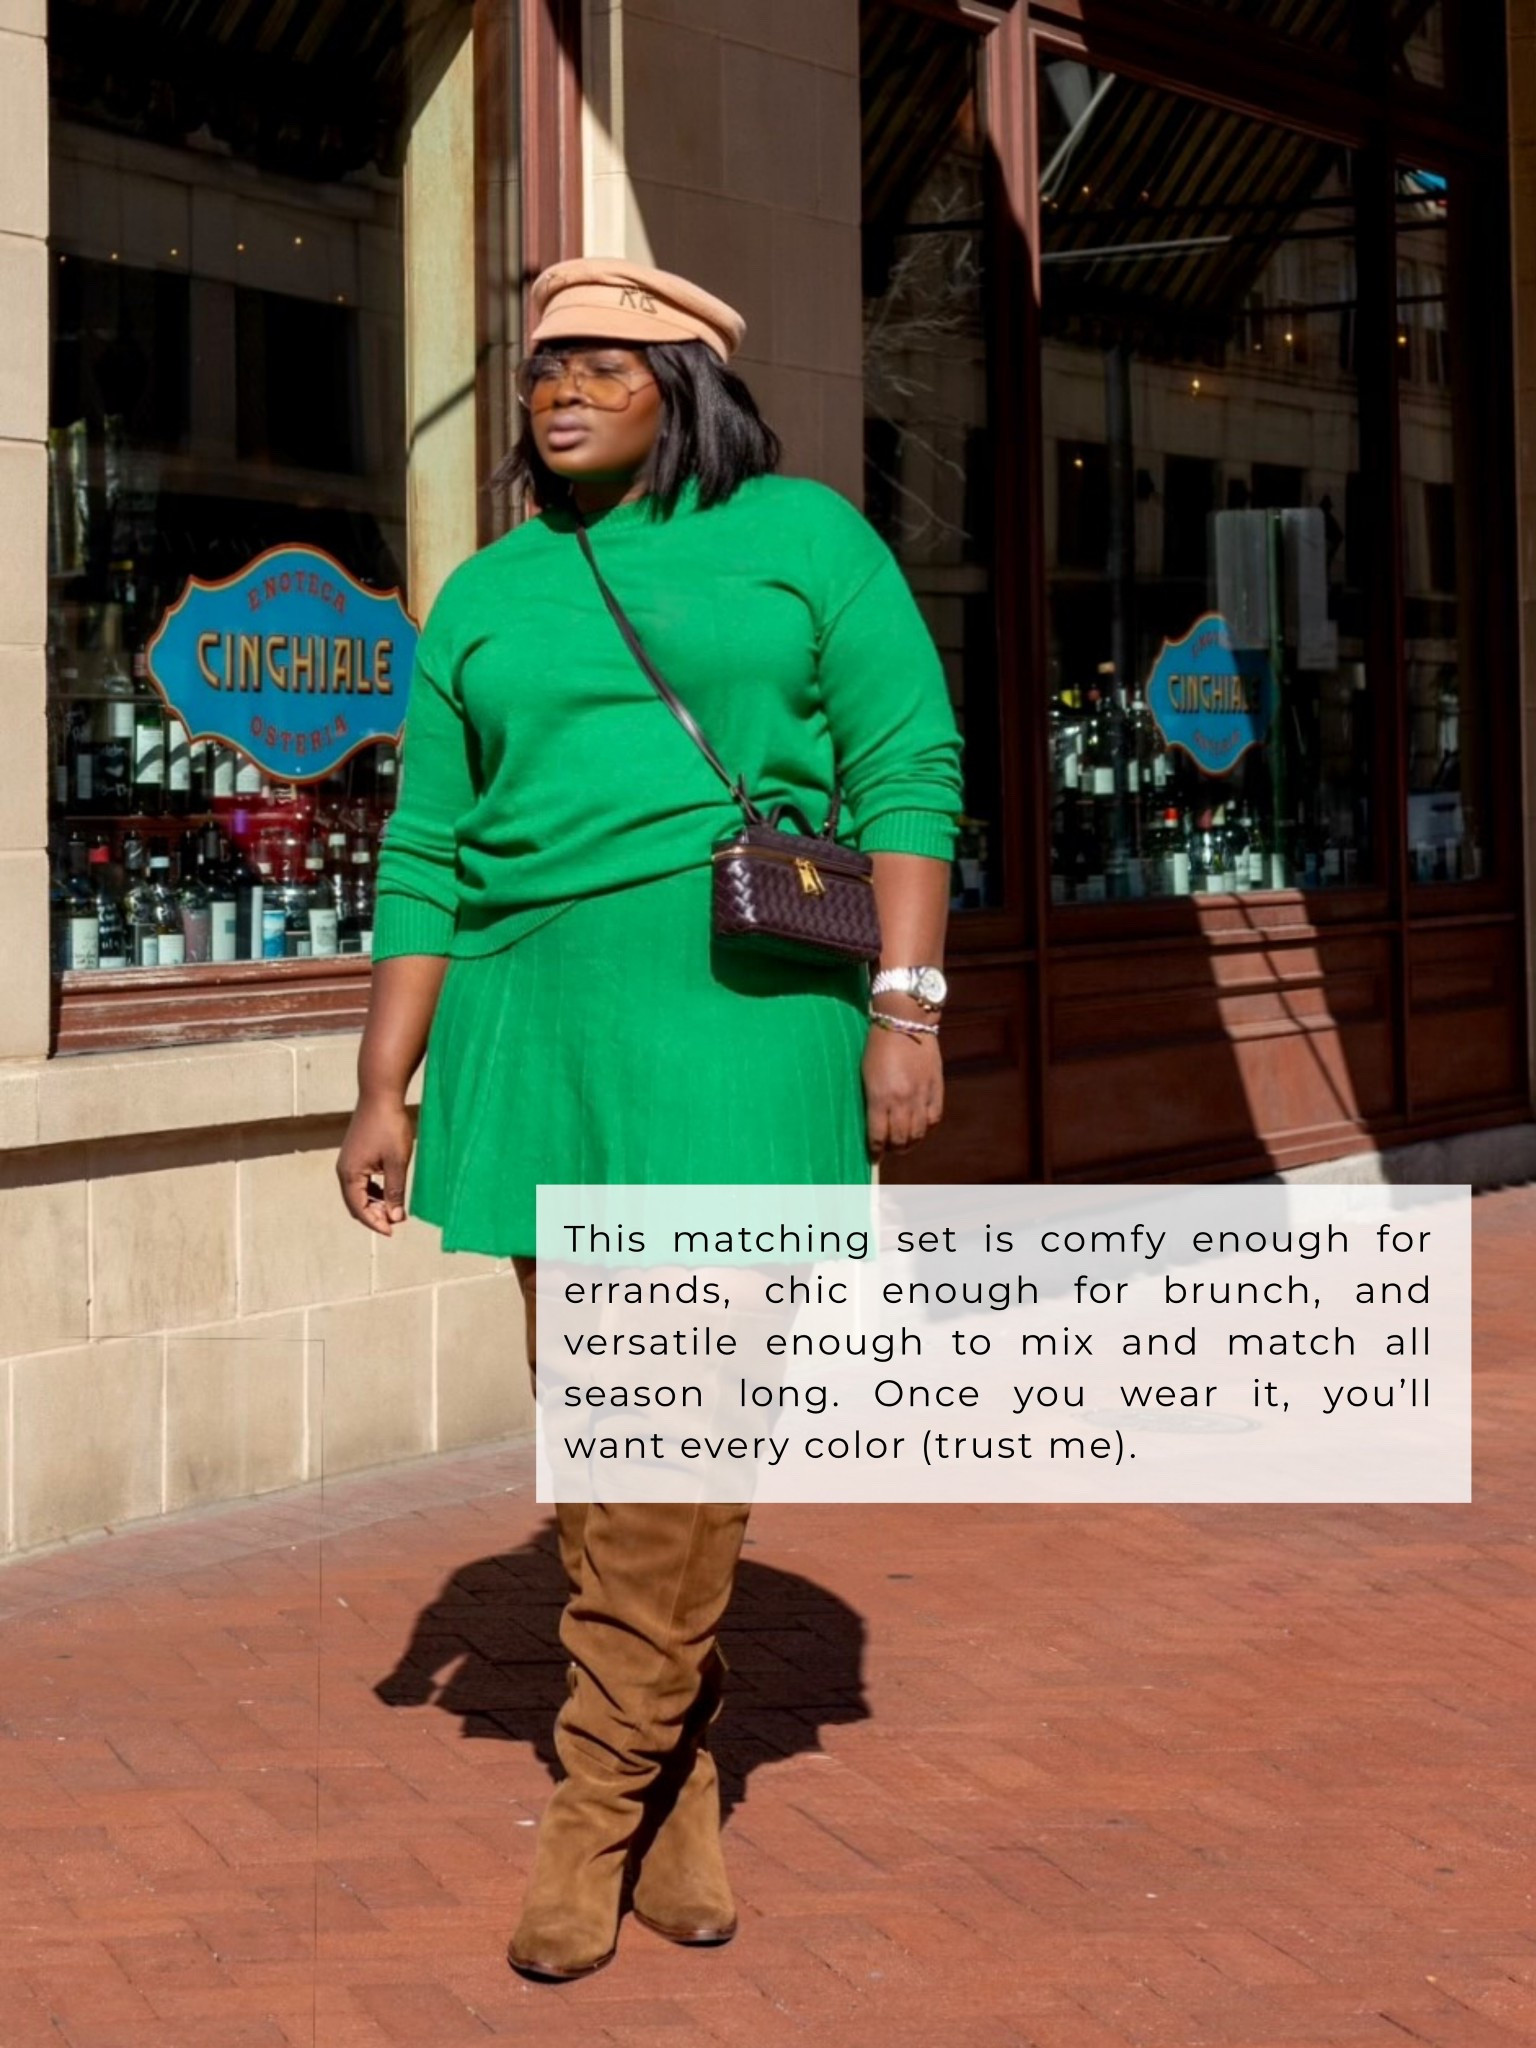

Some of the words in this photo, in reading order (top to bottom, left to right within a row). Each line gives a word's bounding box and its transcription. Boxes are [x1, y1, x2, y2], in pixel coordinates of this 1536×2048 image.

[248, 571, 346, 614] ENOTECA
[196, 630, 394, 694] CINGHIALE
[251, 714, 348, 756] OSTERIA
